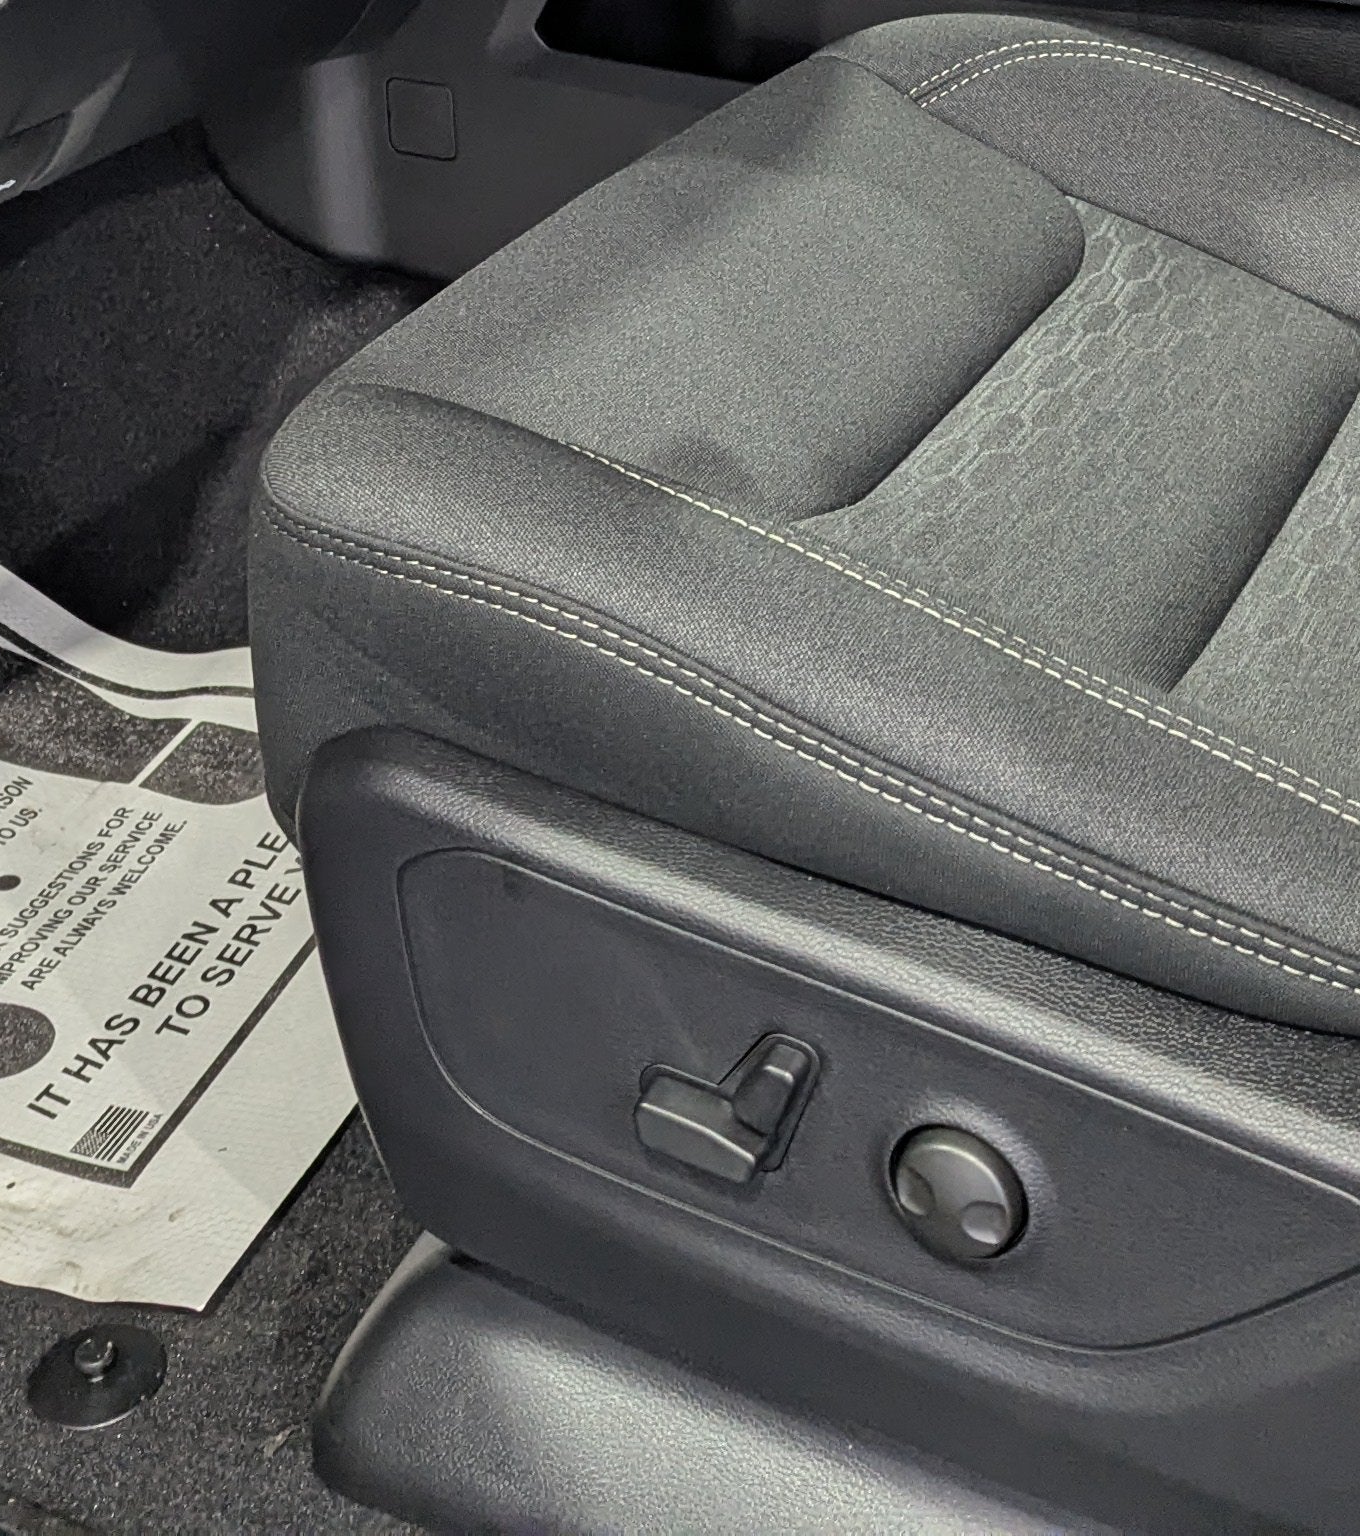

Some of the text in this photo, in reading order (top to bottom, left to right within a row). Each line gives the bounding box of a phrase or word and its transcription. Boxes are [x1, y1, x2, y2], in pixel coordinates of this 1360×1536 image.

[0, 841, 106, 940] SUGGESTIONS
[97, 806, 135, 838] FOR
[9, 807, 43, 828] US.
[67, 875, 108, 906] OUR
[98, 811, 163, 873] SERVICE
[20, 820, 188, 991] ARE ALWAYS WELCOME.
[154, 882, 302, 1038] TO SERVE
[26, 1083, 71, 1120] IT
[61, 1013, 141, 1084] HAS
[128, 920, 220, 1009] BEEN
[208, 897, 245, 919] A
[116, 1113, 164, 1164] MADE IN USA
